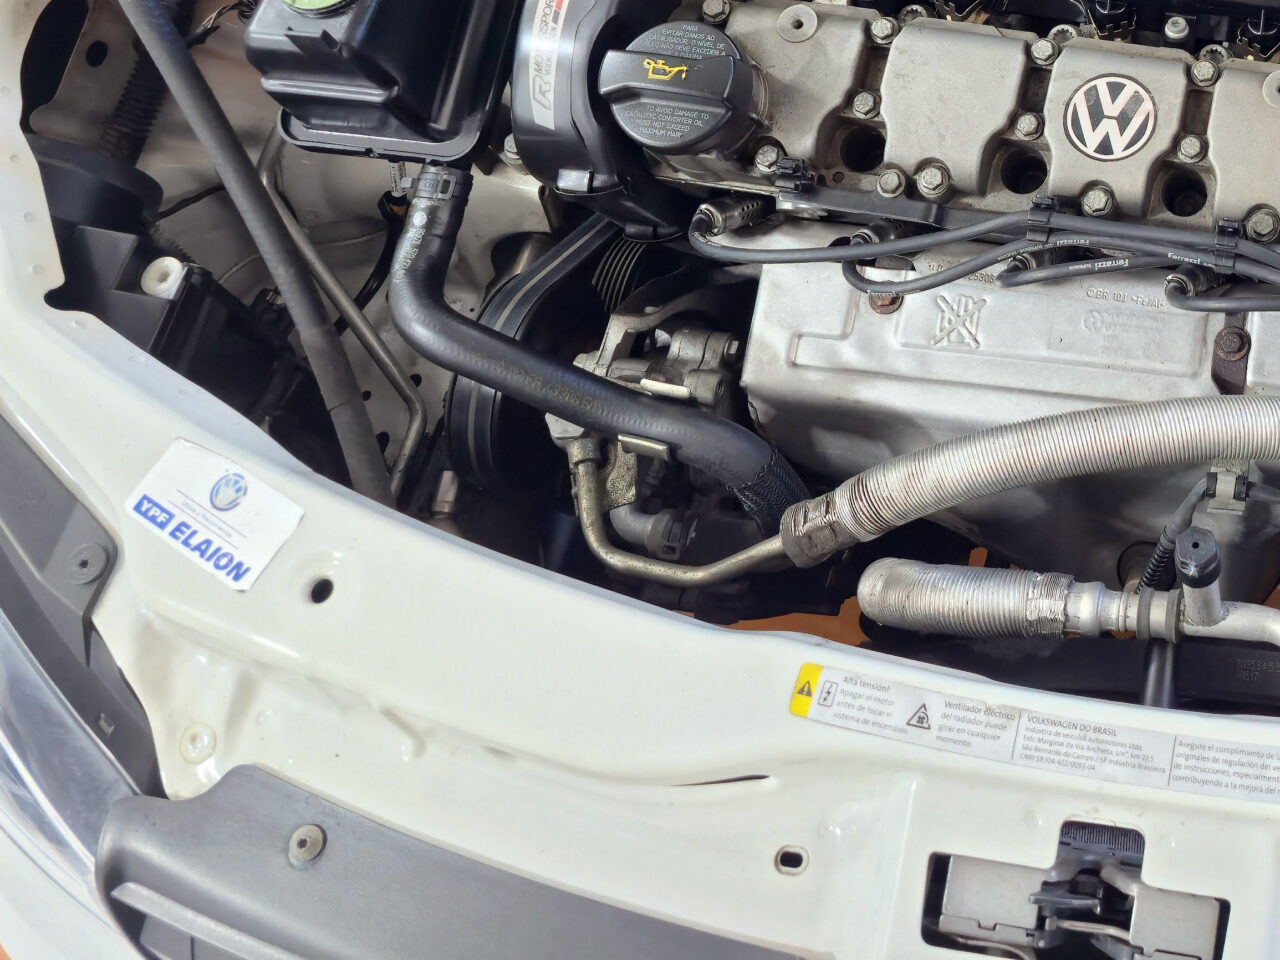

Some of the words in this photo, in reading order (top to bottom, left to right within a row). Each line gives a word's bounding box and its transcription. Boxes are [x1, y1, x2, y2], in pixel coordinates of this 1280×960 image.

[662, 28, 684, 37] EVITAR
[685, 32, 705, 40] DANOS
[691, 47, 719, 56] EXCEDER
[655, 106, 673, 115] AVOID
[674, 109, 699, 119] DAMAGE
[1095, 257, 1129, 272] Ferrazzi
[1167, 251, 1201, 266] Ferrazzi
[137, 497, 173, 526] YPF
[168, 521, 252, 582] ELAION
[842, 676, 859, 687] Alta
[839, 688, 865, 701] Apagar
[865, 693, 873, 701] el
[873, 695, 896, 706] motor
[836, 700, 856, 710] antes
[856, 703, 867, 712] de
[867, 706, 885, 717] tocar
[944, 700, 983, 714] Ventilador
[832, 712, 860, 723] sistema
[861, 717, 871, 726] de
[941, 711, 953, 720] del
[953, 714, 984, 726] radiador
[984, 721, 1008, 732] puede
[1027, 714, 1078, 731] VOLKSWAGEN
[1079, 723, 1092, 733] DO
[1092, 724, 1118, 737] BRASIL
[937, 723, 956, 733] girar
[956, 726, 966, 734] en
[966, 729, 1002, 742] cualquier
[1053, 728, 1062, 738] de
[1088, 734, 1128, 749] automotores
[1037, 736, 1065, 749] Marginal
[1065, 739, 1074, 748] da
[1075, 740, 1085, 750] Via
[1177, 739, 1207, 751] Asegure
[1207, 744, 1215, 752] el
[1215, 746, 1265, 759] cumplimiento
[1265, 751, 1276, 760] de
[1033, 745, 1062, 758] Bernardo
[1062, 749, 1072, 758] do
[1072, 750, 1095, 763] Campo
[1099, 754, 1108, 763] SP
[1137, 760, 1166, 774] Brasileira
[1173, 762, 1183, 770] de
[1175, 752, 1211, 764] originales
[1211, 756, 1221, 764] de
[1259, 762, 1271, 770] del
[1172, 774, 1223, 788] contribuyendo
[1238, 783, 1264, 794] mejora
[1264, 786, 1276, 795] del
